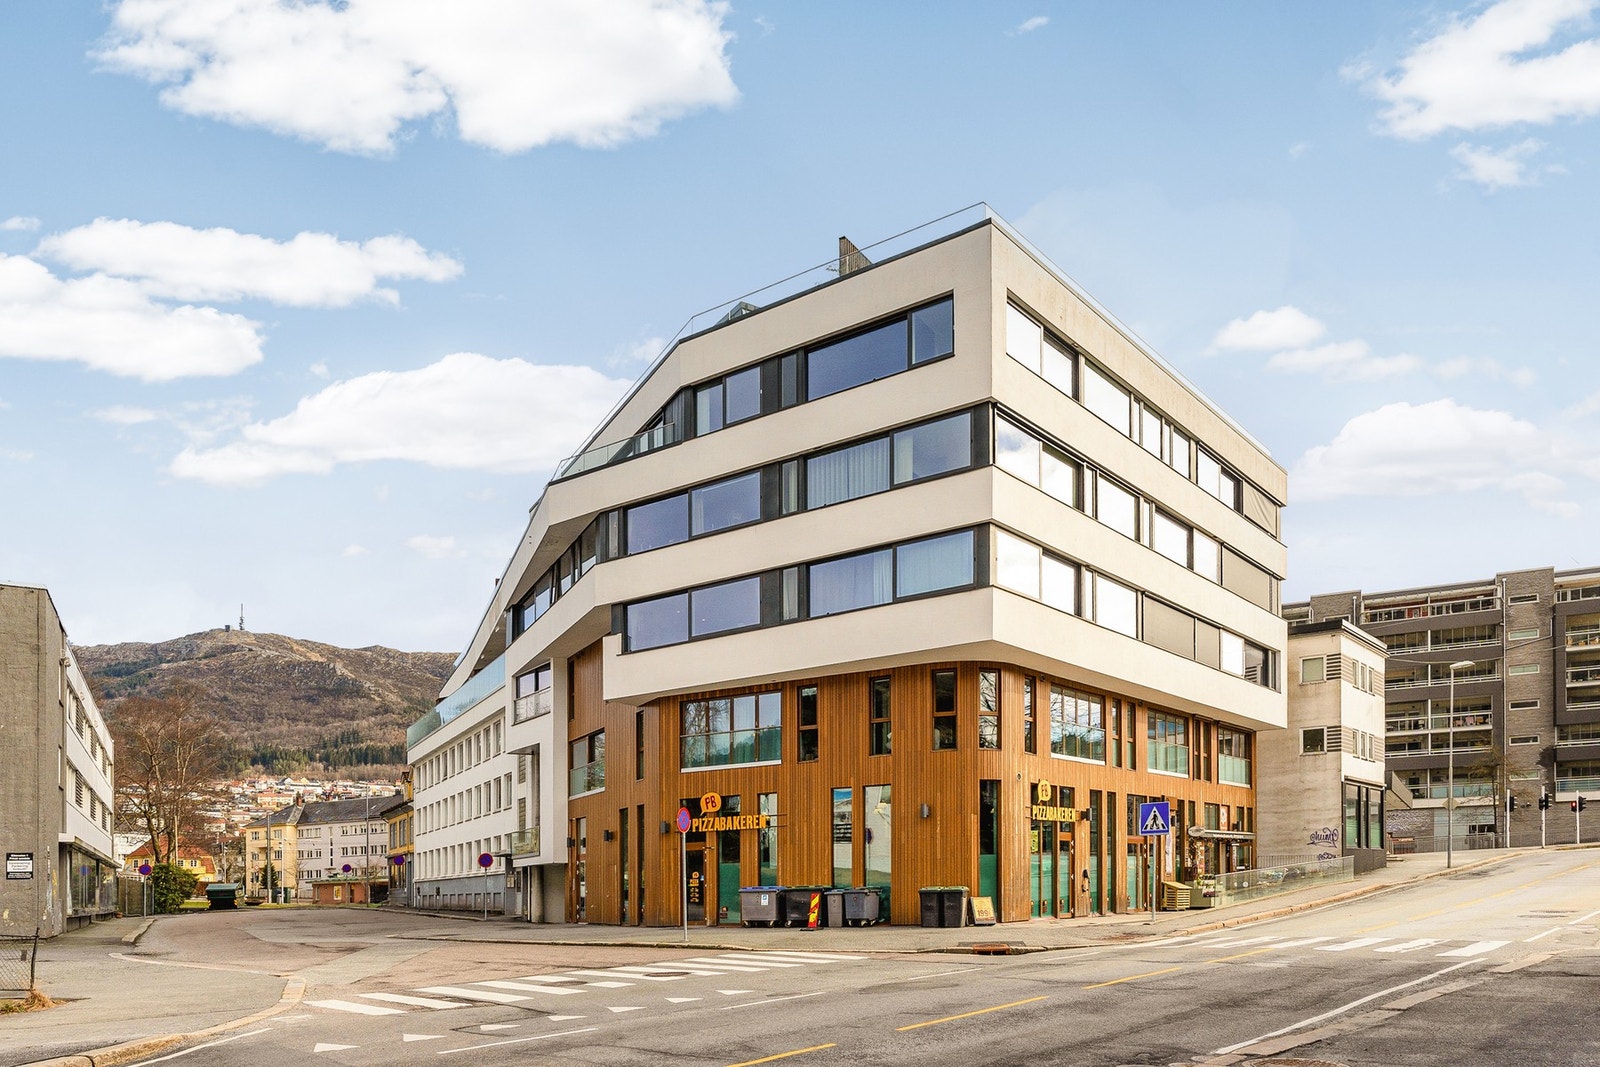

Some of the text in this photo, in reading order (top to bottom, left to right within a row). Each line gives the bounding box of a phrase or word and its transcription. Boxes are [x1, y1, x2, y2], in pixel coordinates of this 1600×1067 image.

[705, 795, 717, 809] PB
[1032, 805, 1075, 822] PIZZABAKEREN
[692, 814, 767, 832] PIZZABAKEREN
